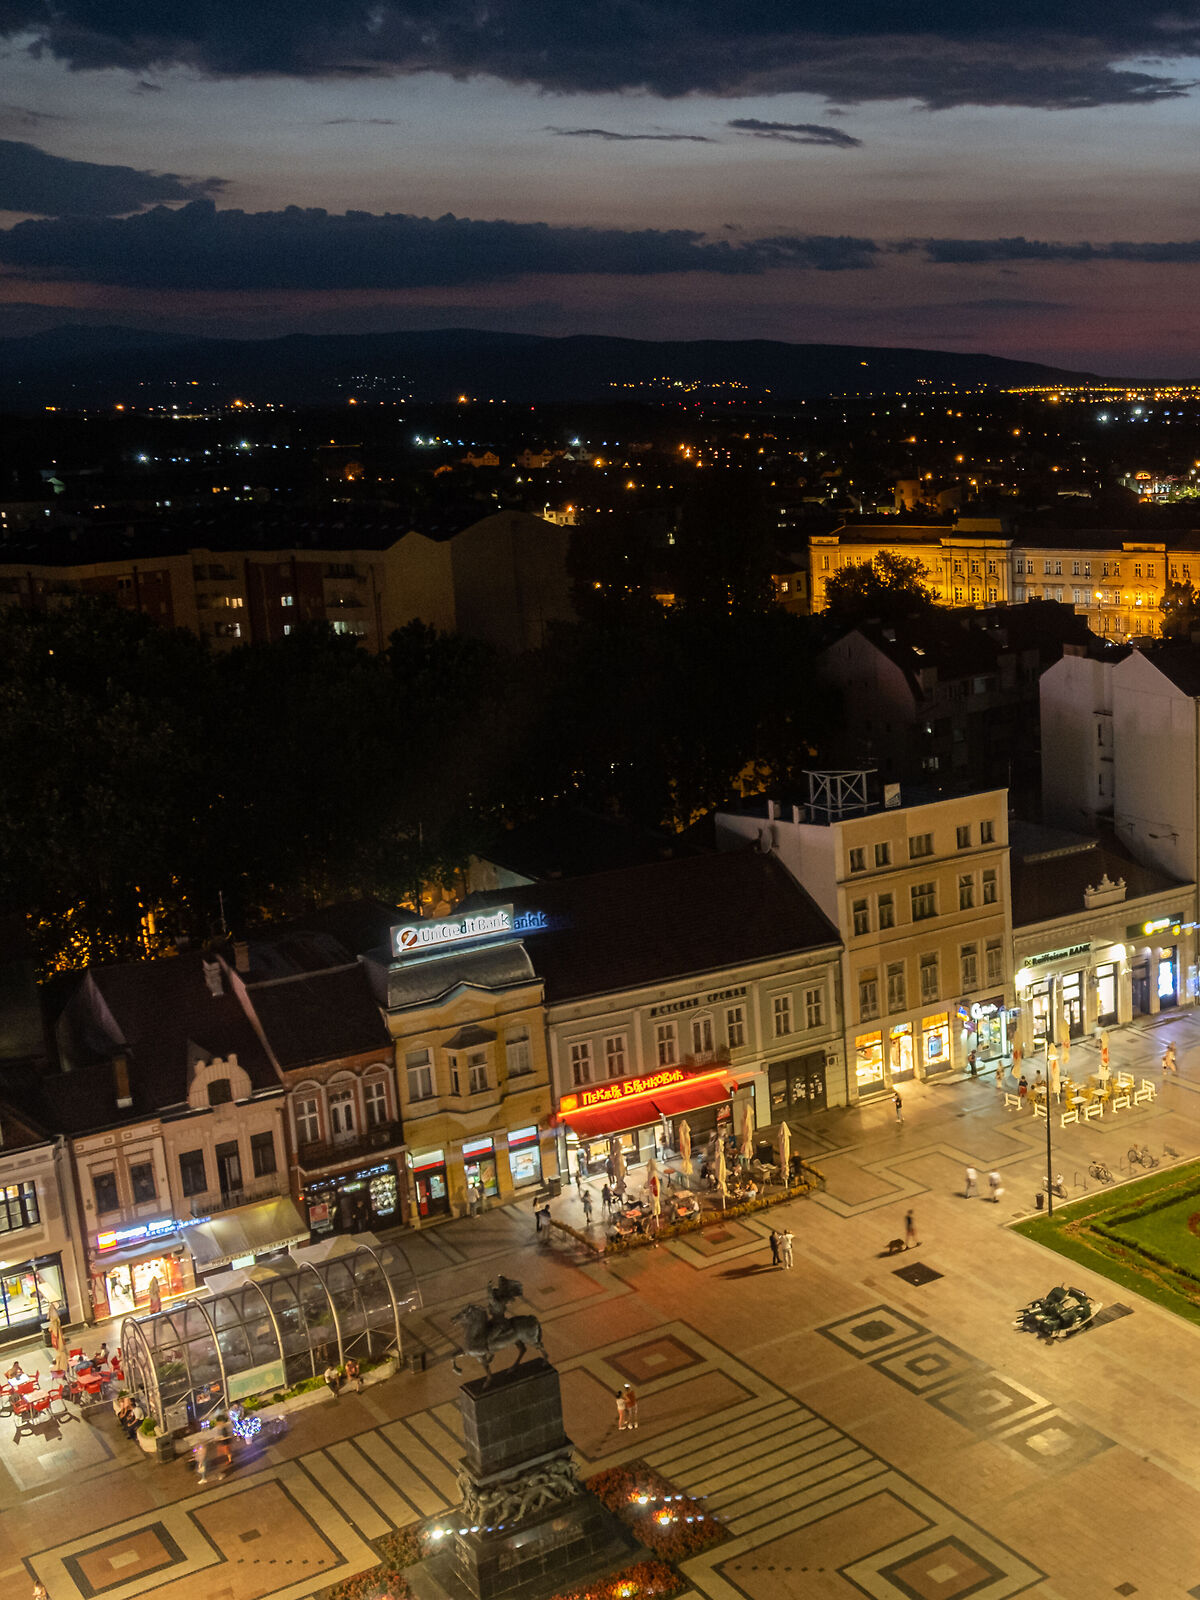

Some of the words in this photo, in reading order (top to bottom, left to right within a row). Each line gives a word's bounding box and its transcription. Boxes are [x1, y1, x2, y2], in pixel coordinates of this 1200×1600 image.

[421, 919, 475, 942] UniCredit
[477, 913, 510, 932] Bank
[1032, 951, 1068, 966] Raiffeisen
[1069, 943, 1091, 956] BANK
